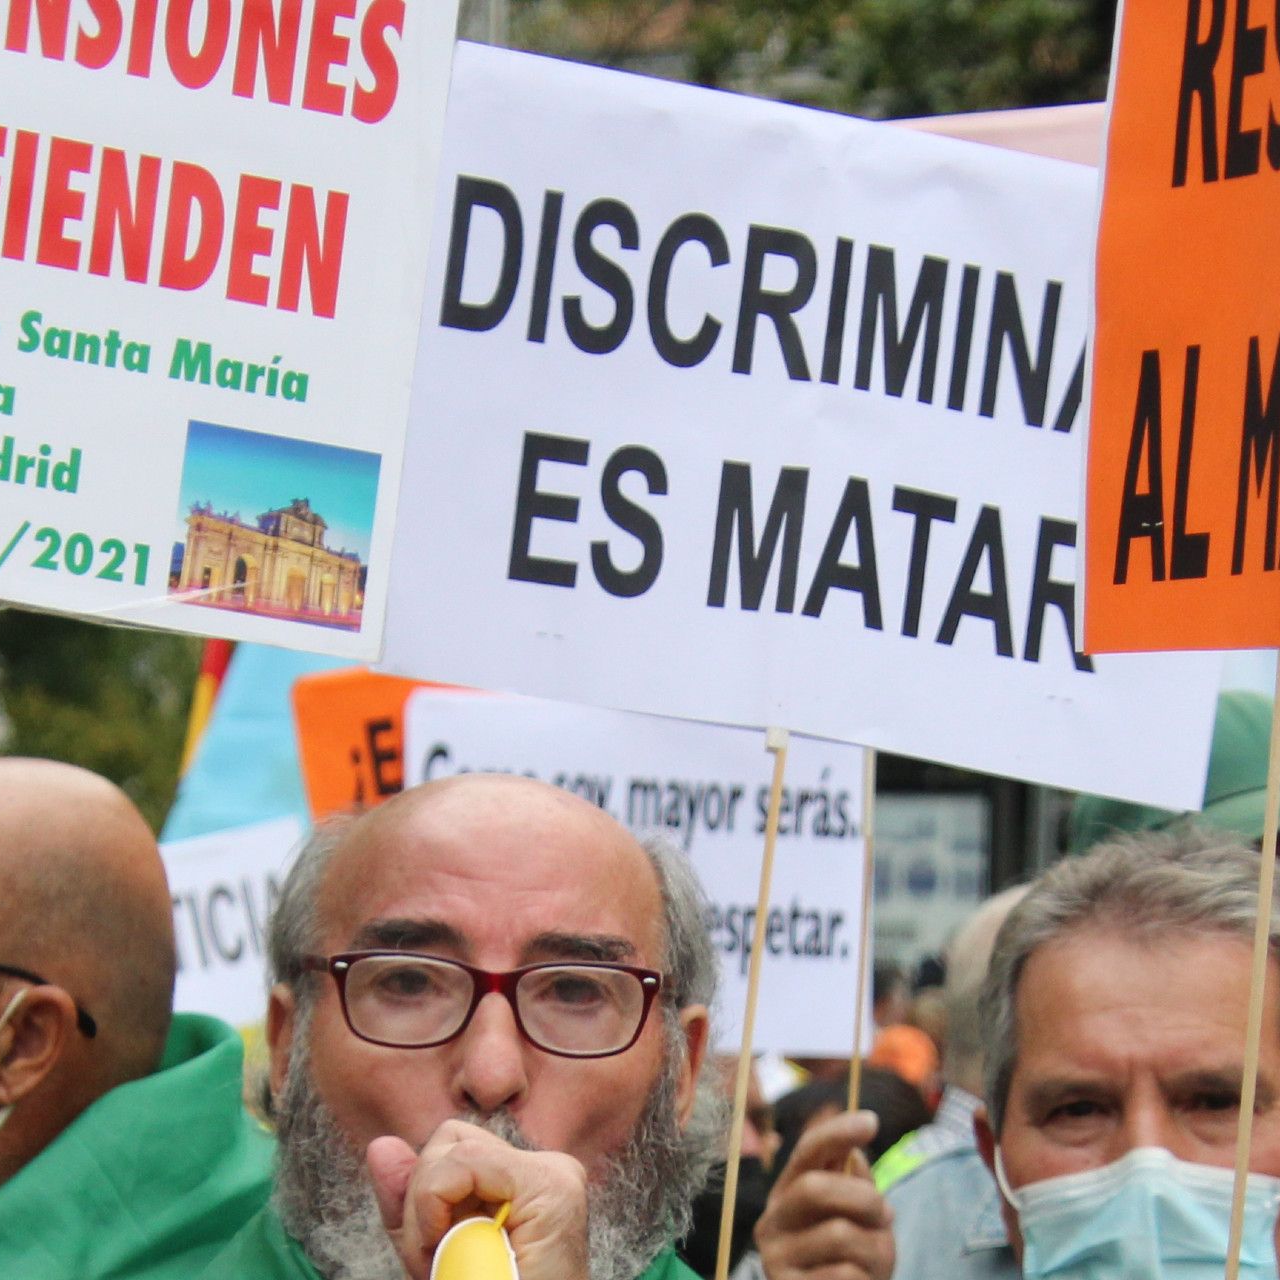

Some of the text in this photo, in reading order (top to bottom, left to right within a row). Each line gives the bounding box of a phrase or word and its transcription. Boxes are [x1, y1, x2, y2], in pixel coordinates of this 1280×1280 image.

[17, 311, 151, 374] Santa
[168, 337, 310, 403] María
[1113, 345, 1210, 585] AL
[508, 431, 1096, 674] ES MATAR
[626, 775, 746, 851] mayor
[754, 766, 859, 841] serás.
